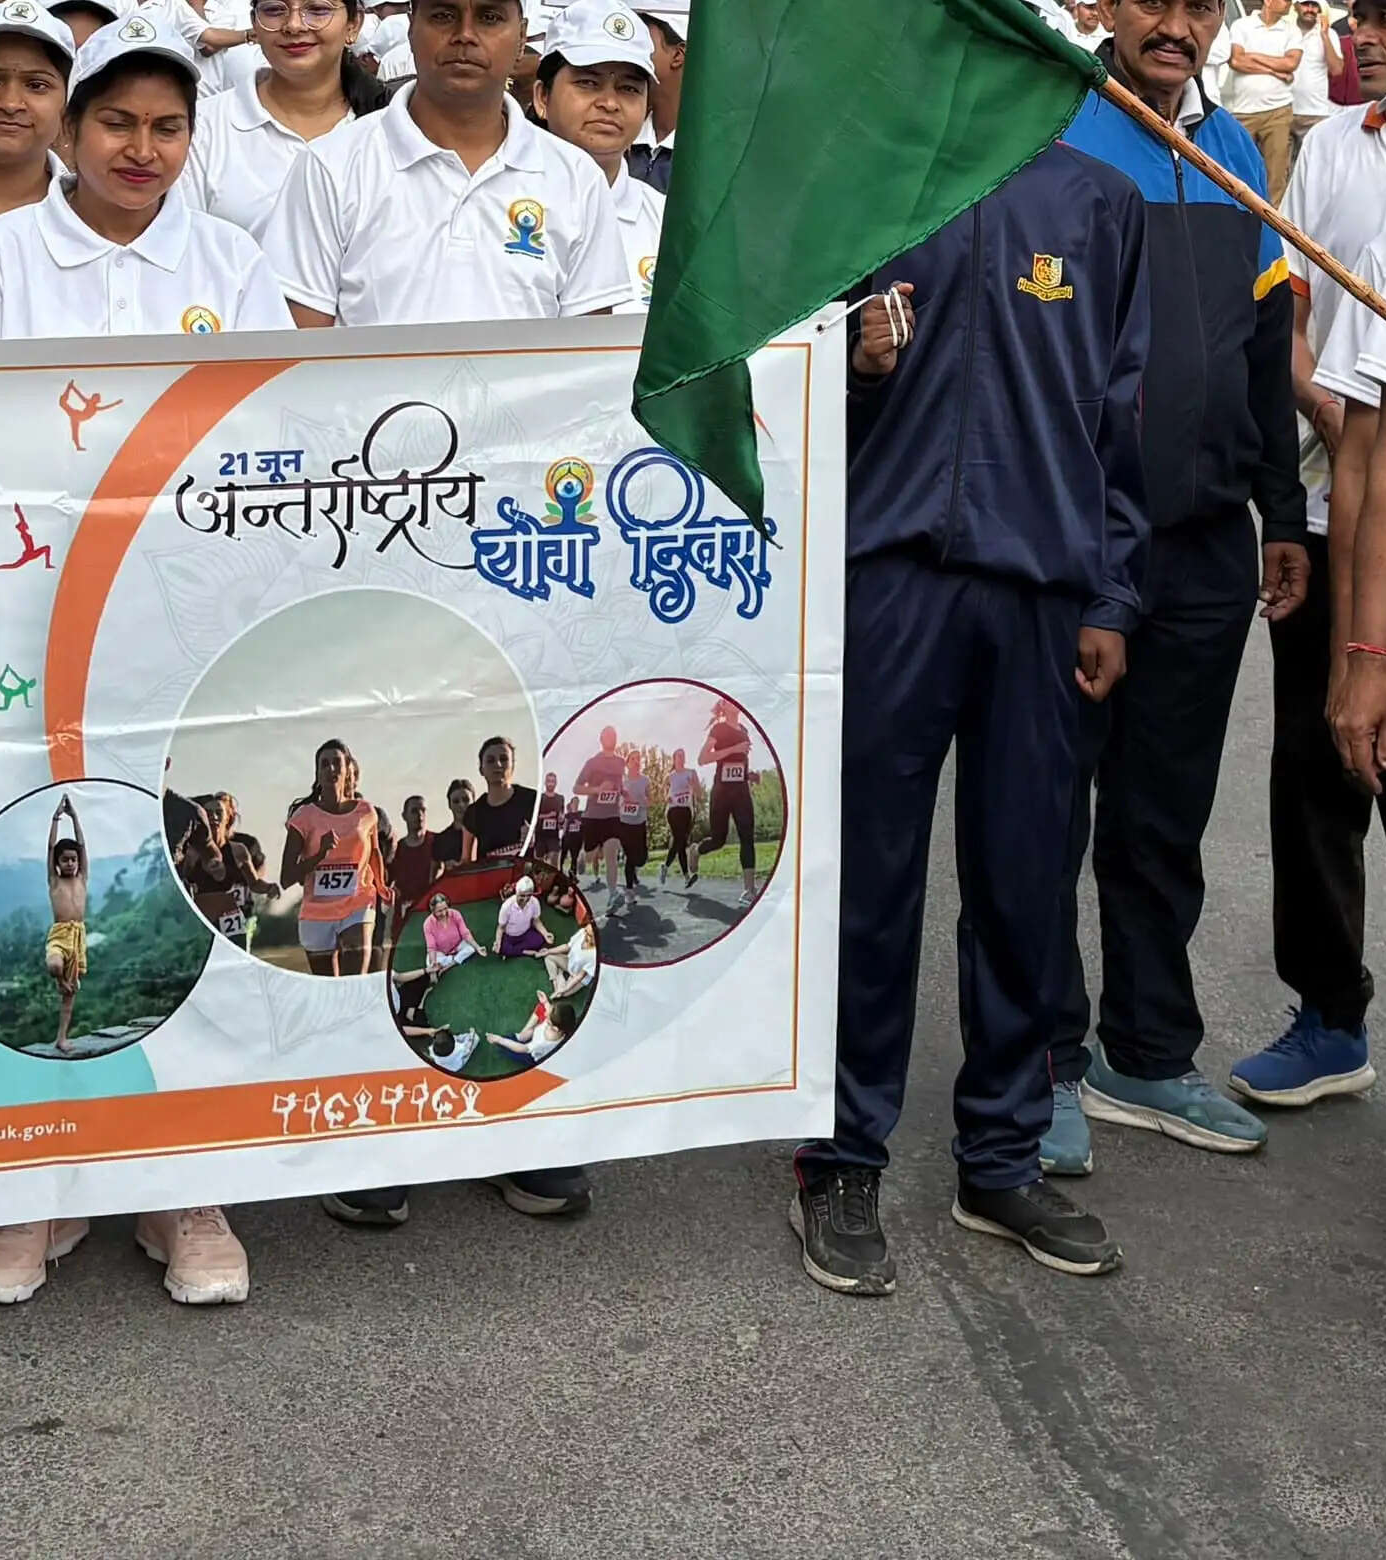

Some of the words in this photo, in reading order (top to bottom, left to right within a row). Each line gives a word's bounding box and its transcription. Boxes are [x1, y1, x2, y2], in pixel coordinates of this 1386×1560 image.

[219, 451, 250, 477] 21
[256, 448, 305, 484] जून
[470, 495, 600, 602] योग
[606, 446, 779, 624] दिवस
[726, 767, 743, 779] 102
[319, 871, 354, 890] 457
[224, 916, 242, 933] 21
